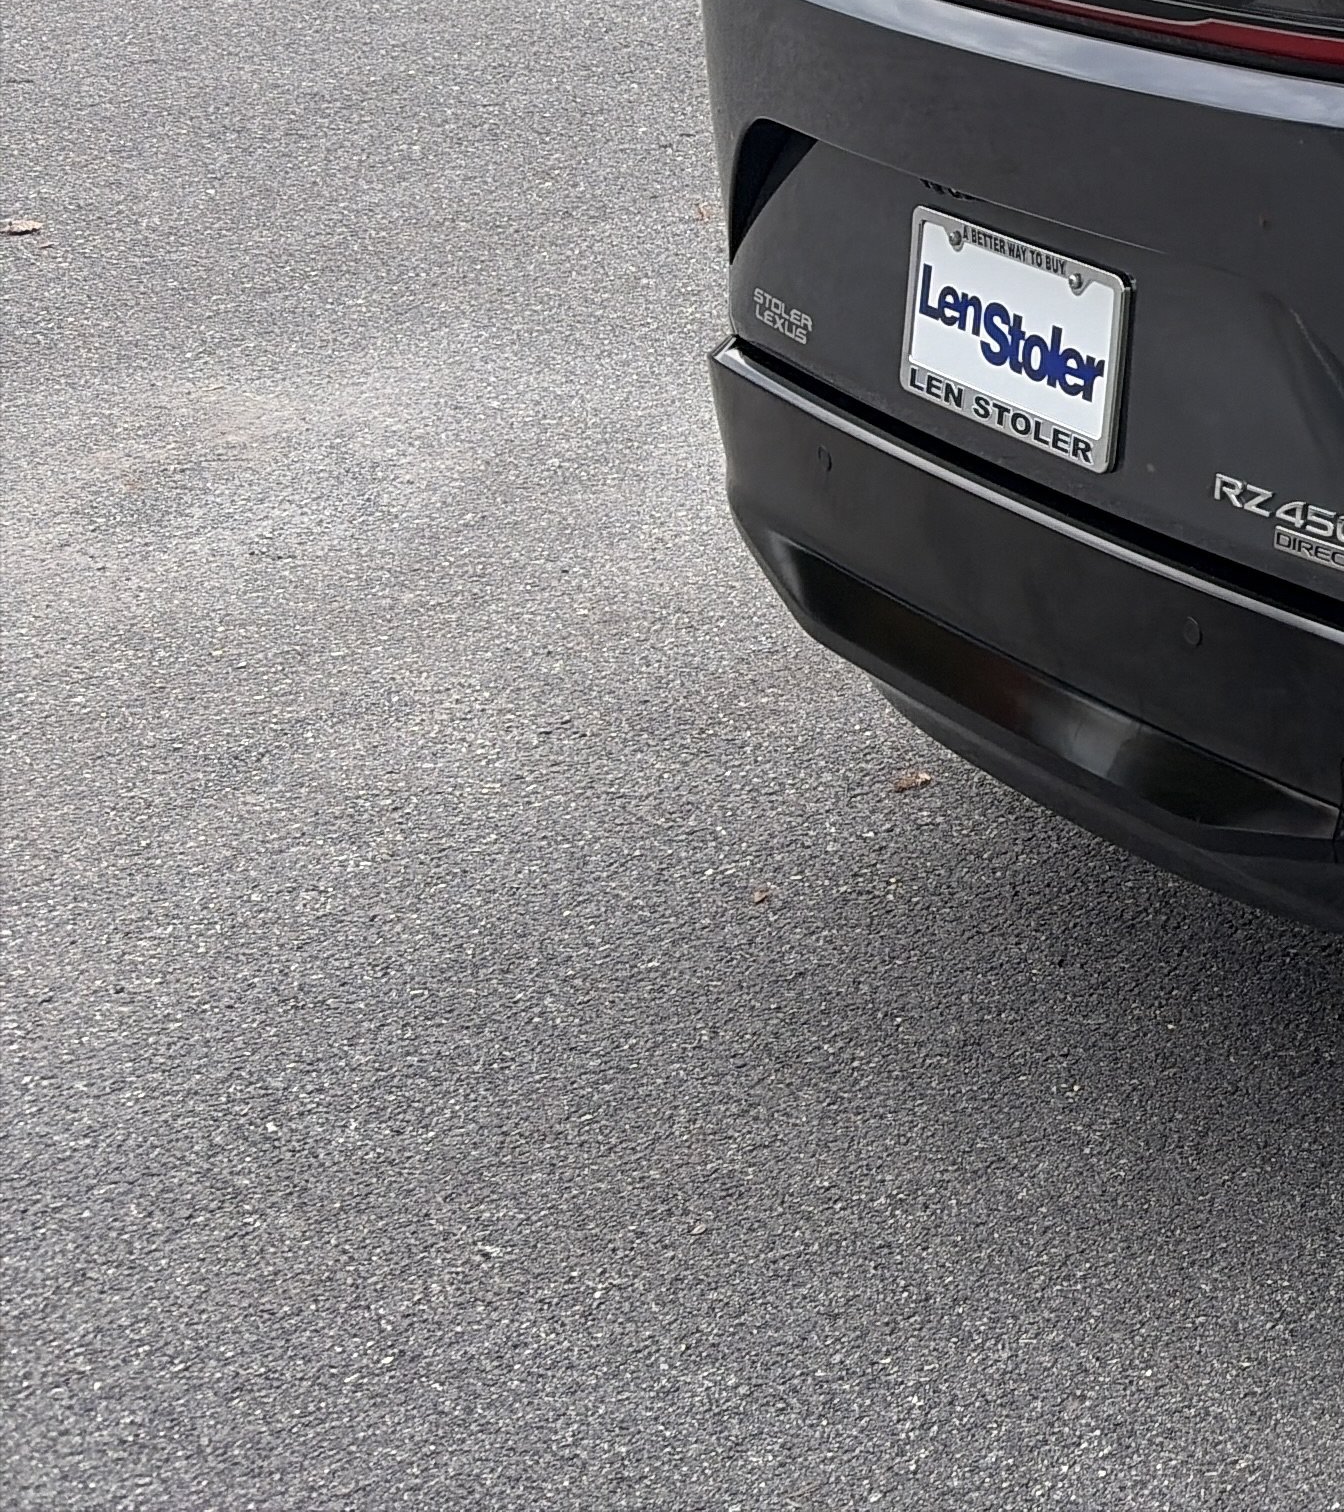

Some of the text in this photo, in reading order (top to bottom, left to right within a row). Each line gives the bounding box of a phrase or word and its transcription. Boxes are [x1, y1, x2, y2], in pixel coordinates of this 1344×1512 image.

[961, 226, 1066, 275] A BETTER WAY TO BUY
[753, 288, 812, 332] STOLER
[755, 304, 807, 344] LEXUS
[910, 368, 1093, 463] LEN STOLER
